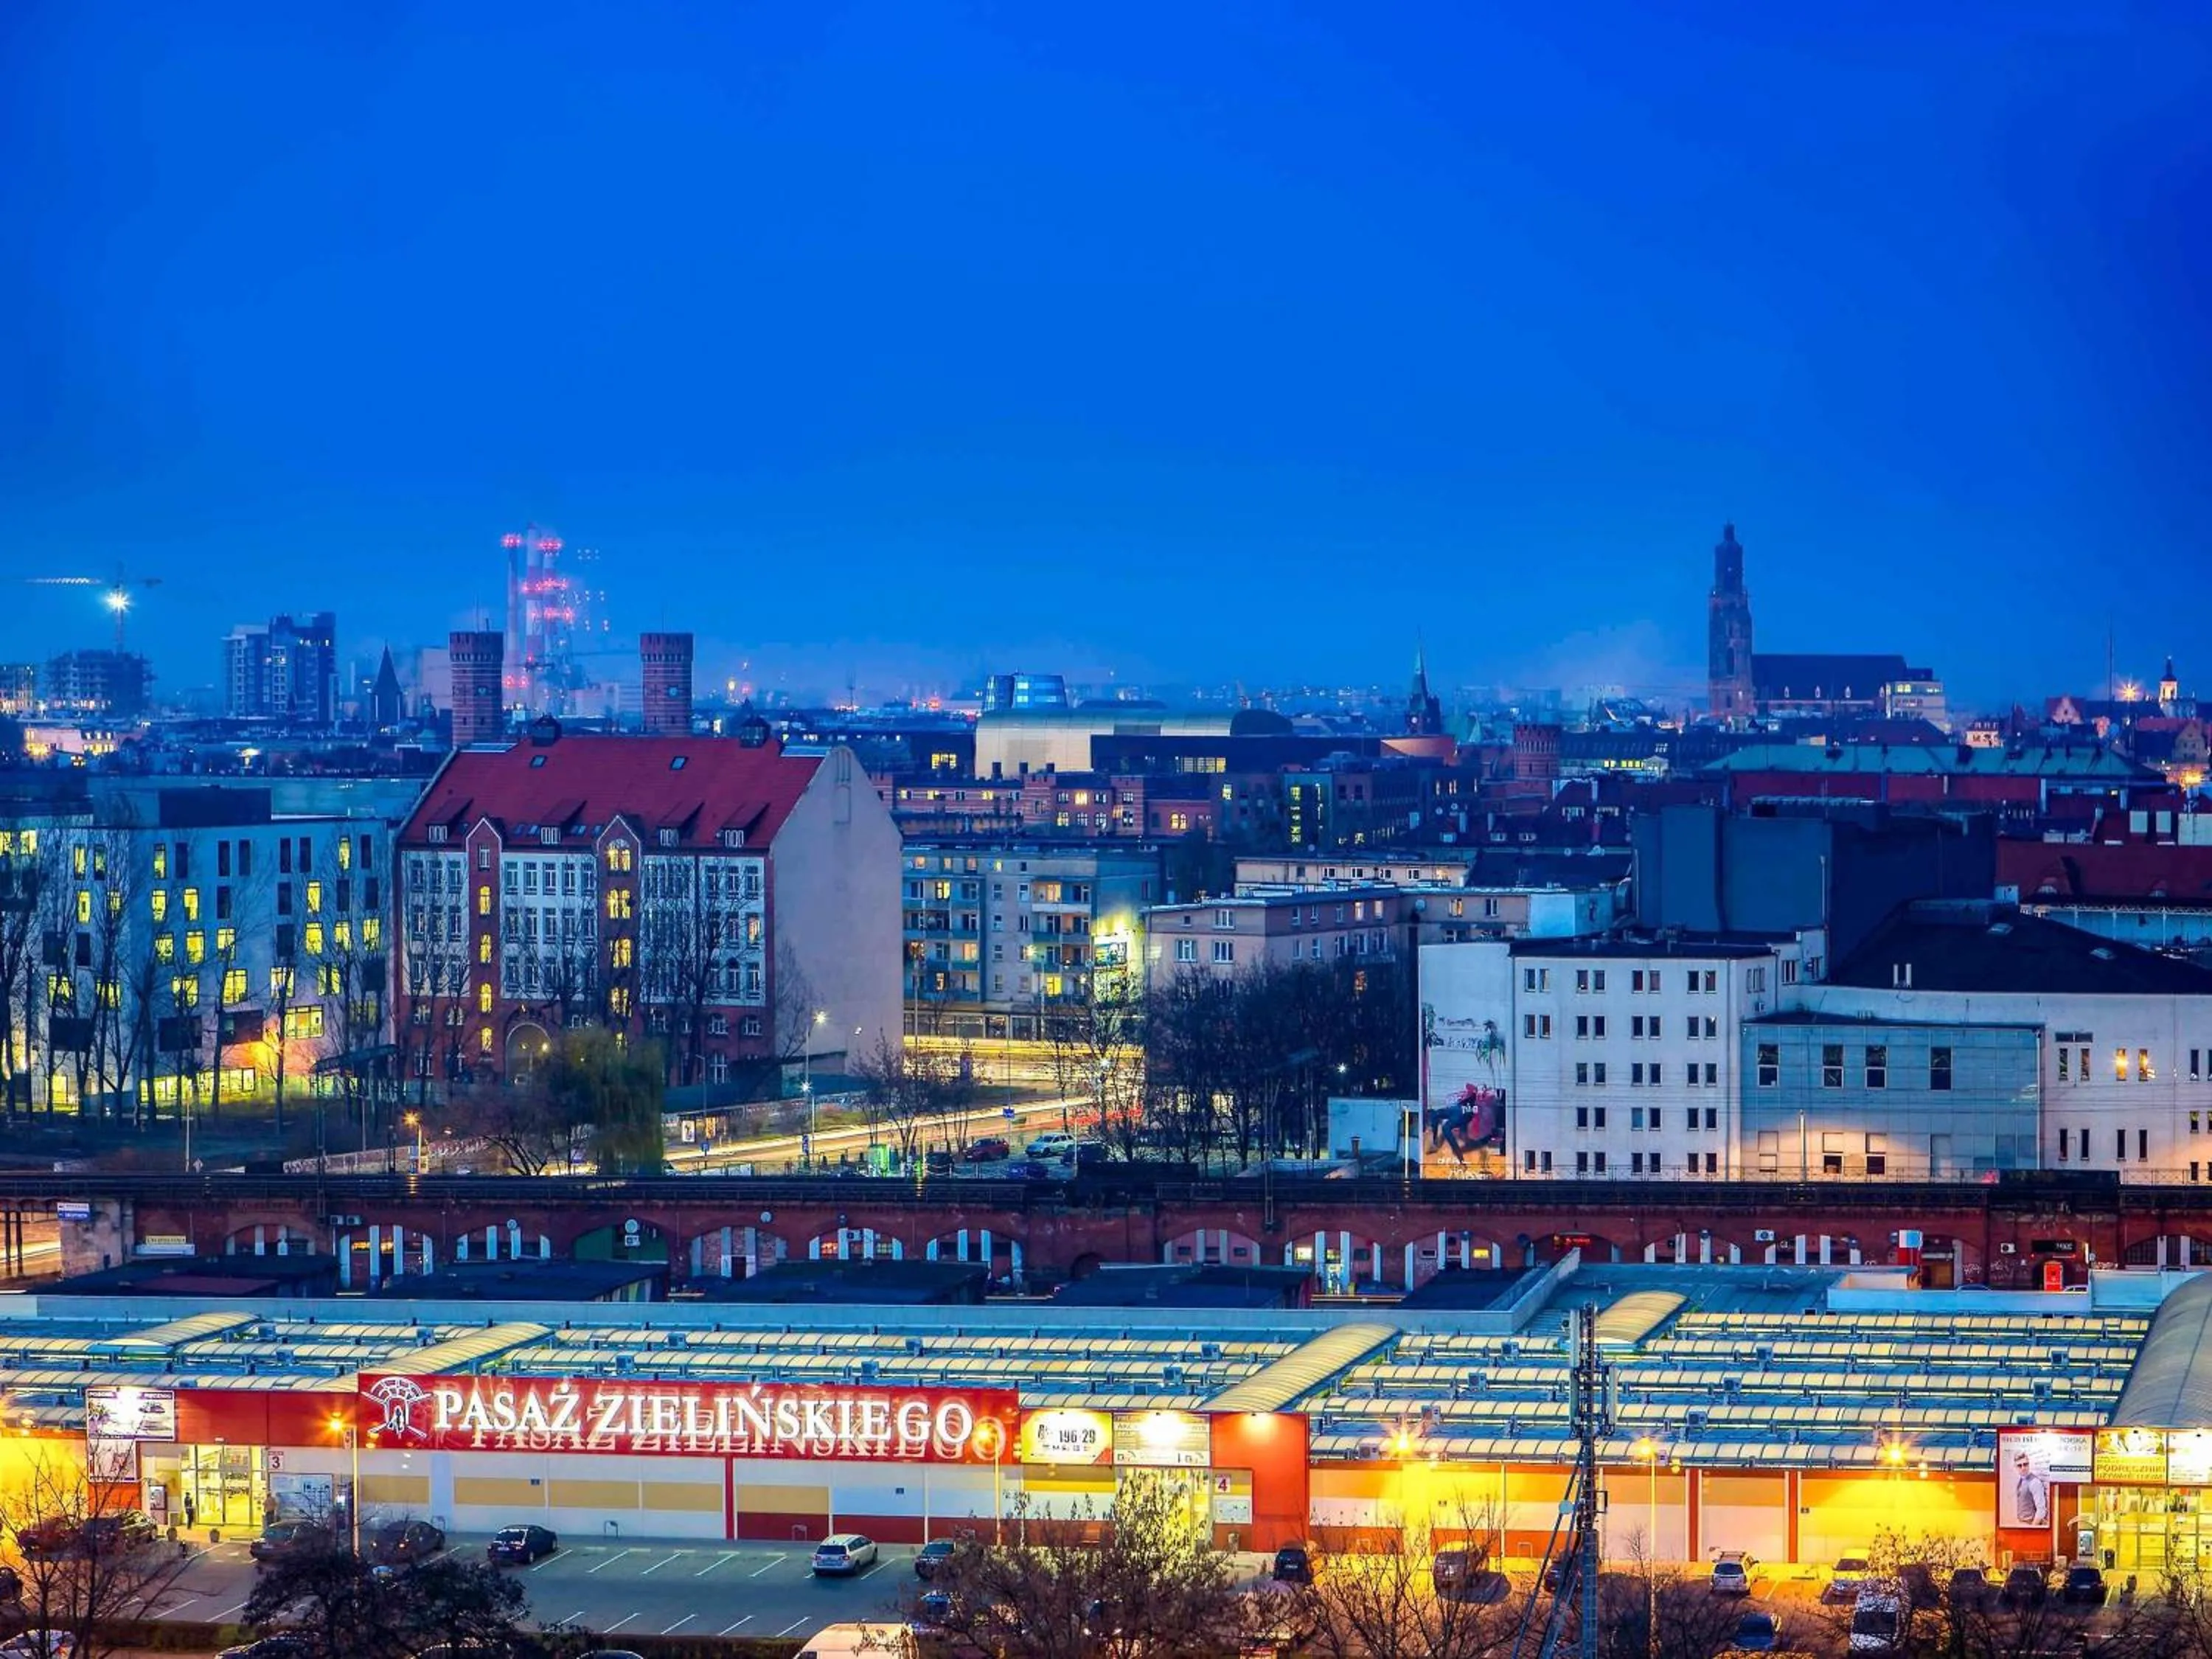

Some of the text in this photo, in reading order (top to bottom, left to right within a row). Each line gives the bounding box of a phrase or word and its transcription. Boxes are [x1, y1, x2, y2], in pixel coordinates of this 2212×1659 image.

[433, 1380, 974, 1443] PASAŻ ZIELIŃSKIEGO
[271, 1456, 280, 1469] 3
[1217, 1478, 1228, 1492] 4
